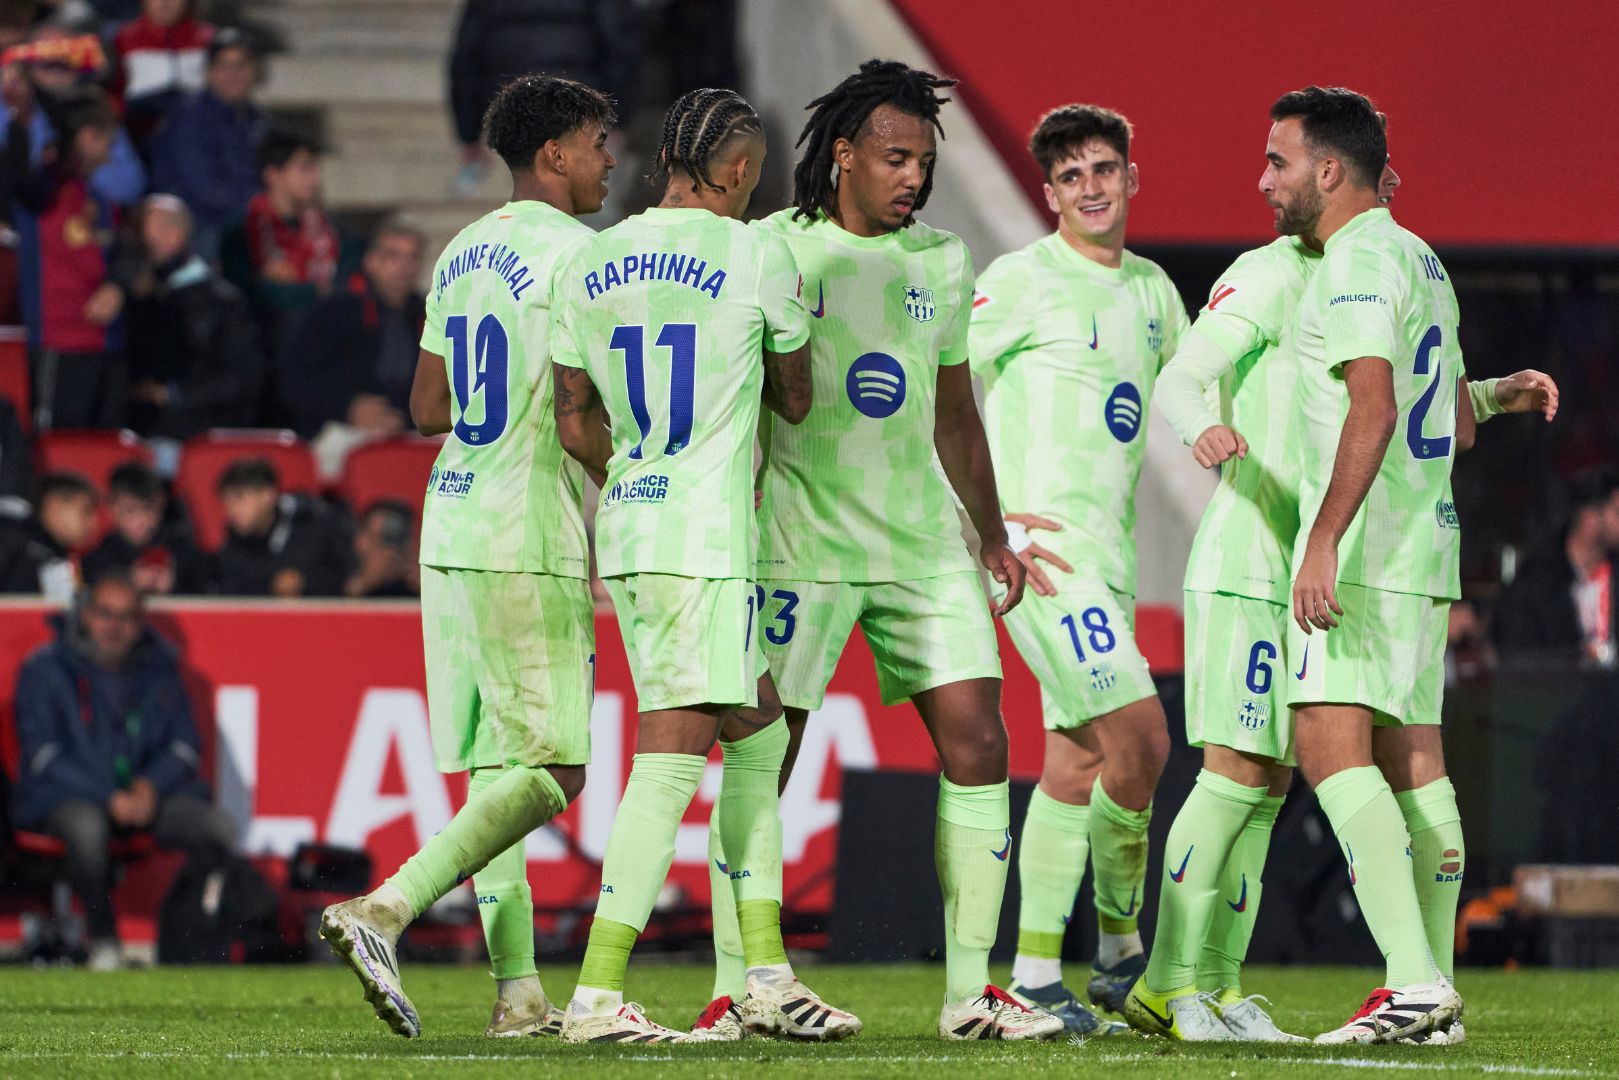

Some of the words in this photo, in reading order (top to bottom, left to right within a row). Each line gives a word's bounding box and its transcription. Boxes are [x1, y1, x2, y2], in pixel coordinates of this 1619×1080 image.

[437, 244, 489, 303] AMINE
[585, 253, 727, 300] RAPHINHA
[1330, 294, 1378, 306] AMBILIGHT
[445, 313, 510, 447] 19
[608, 323, 698, 461] 11
[1407, 324, 1460, 459] 2
[1060, 606, 1116, 663] 18
[1245, 639, 1278, 695] 6
